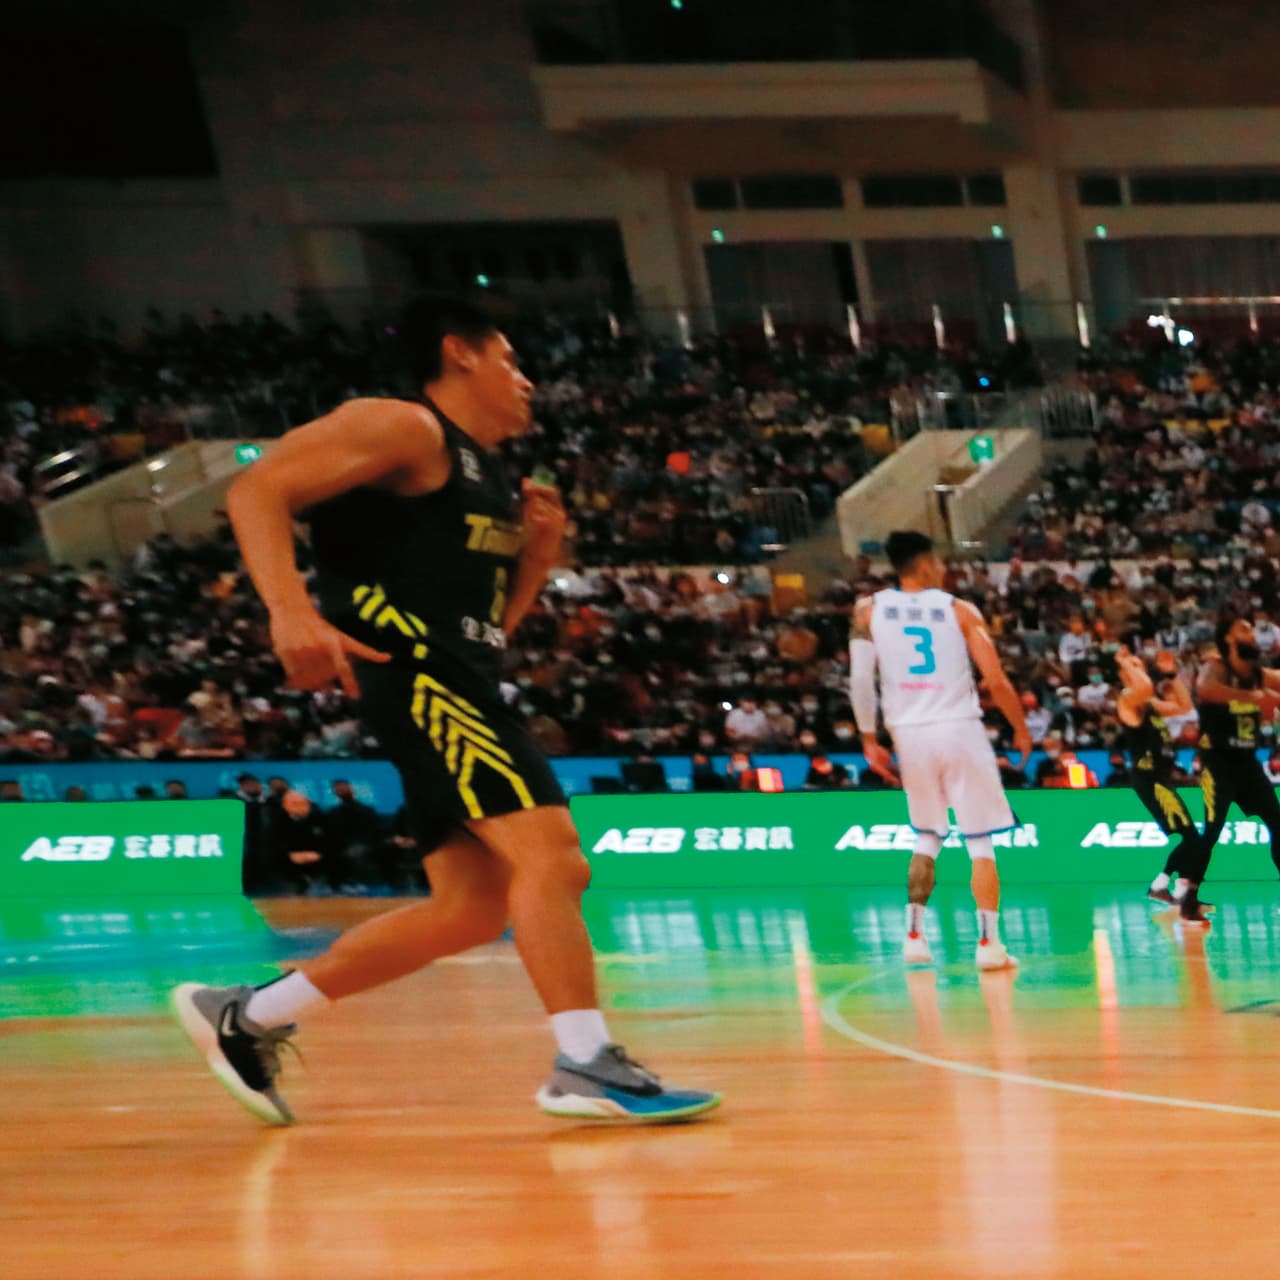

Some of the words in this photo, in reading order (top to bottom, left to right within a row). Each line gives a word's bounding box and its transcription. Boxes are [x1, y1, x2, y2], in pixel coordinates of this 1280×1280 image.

[904, 626, 936, 674] 3
[20, 836, 115, 862] AEB
[592, 827, 686, 854] AEB
